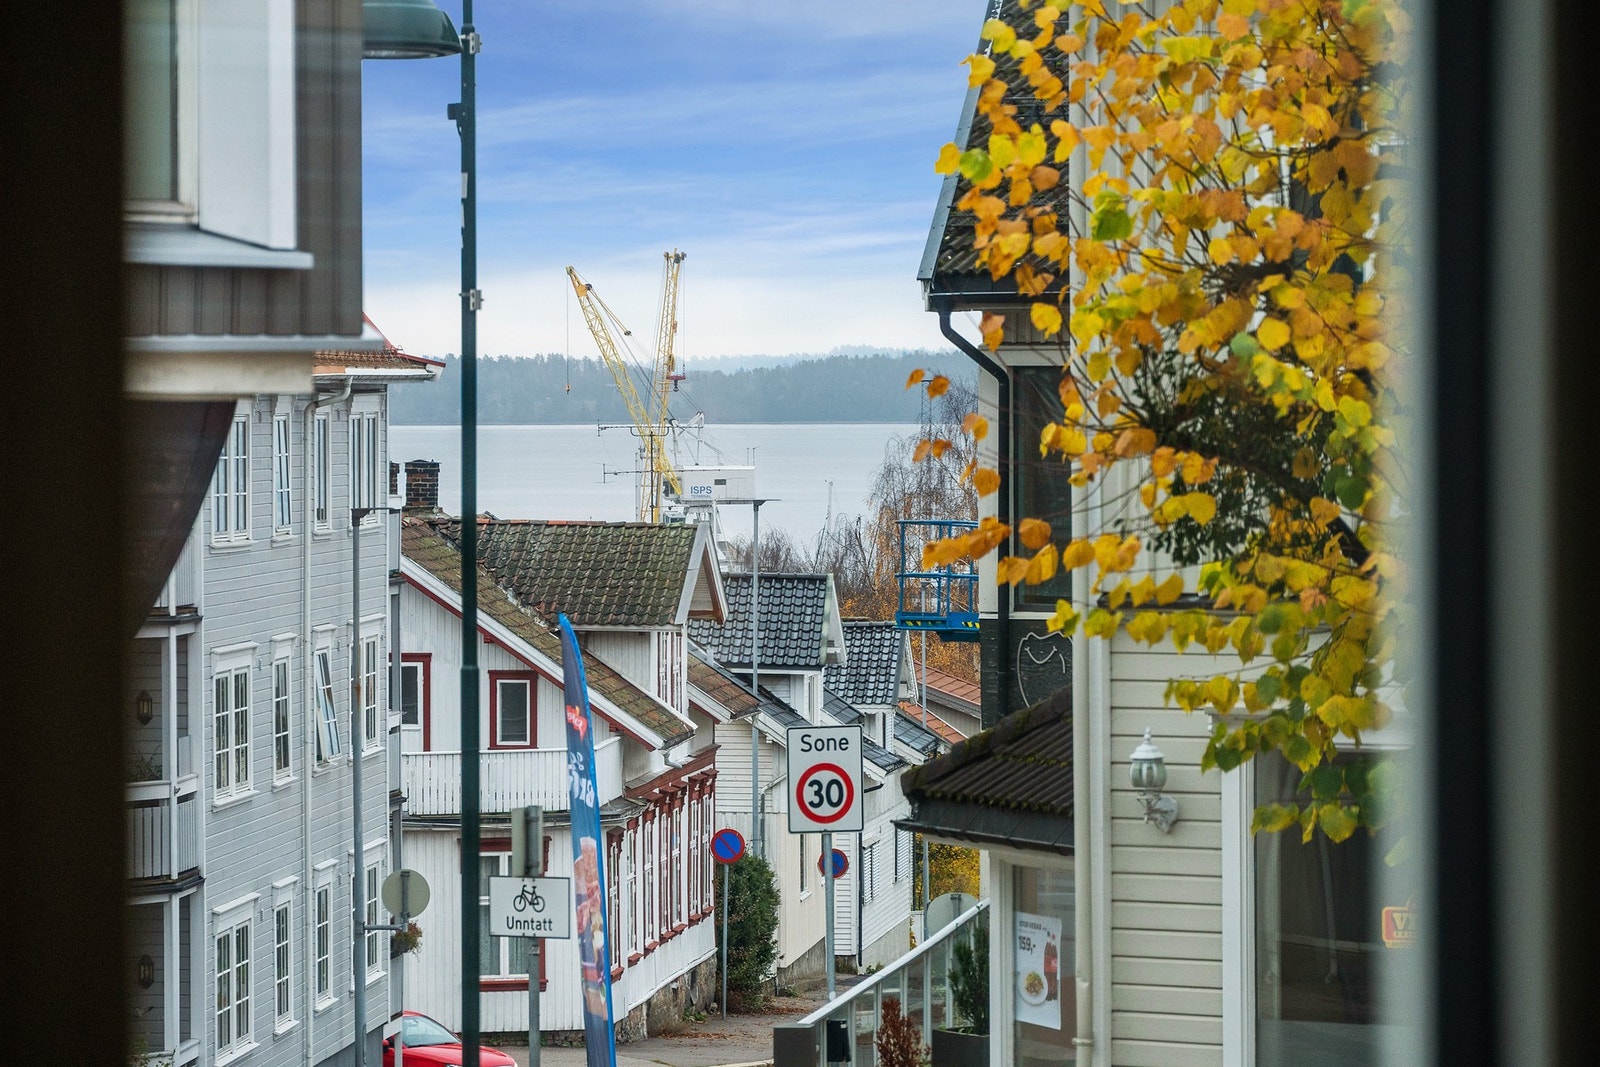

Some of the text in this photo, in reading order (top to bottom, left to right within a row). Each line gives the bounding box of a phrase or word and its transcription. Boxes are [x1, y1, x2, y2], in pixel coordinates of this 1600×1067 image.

[690, 485, 712, 494] ISPS
[800, 734, 849, 752] Sone
[808, 779, 844, 809] 30
[506, 916, 552, 931] Unntatt
